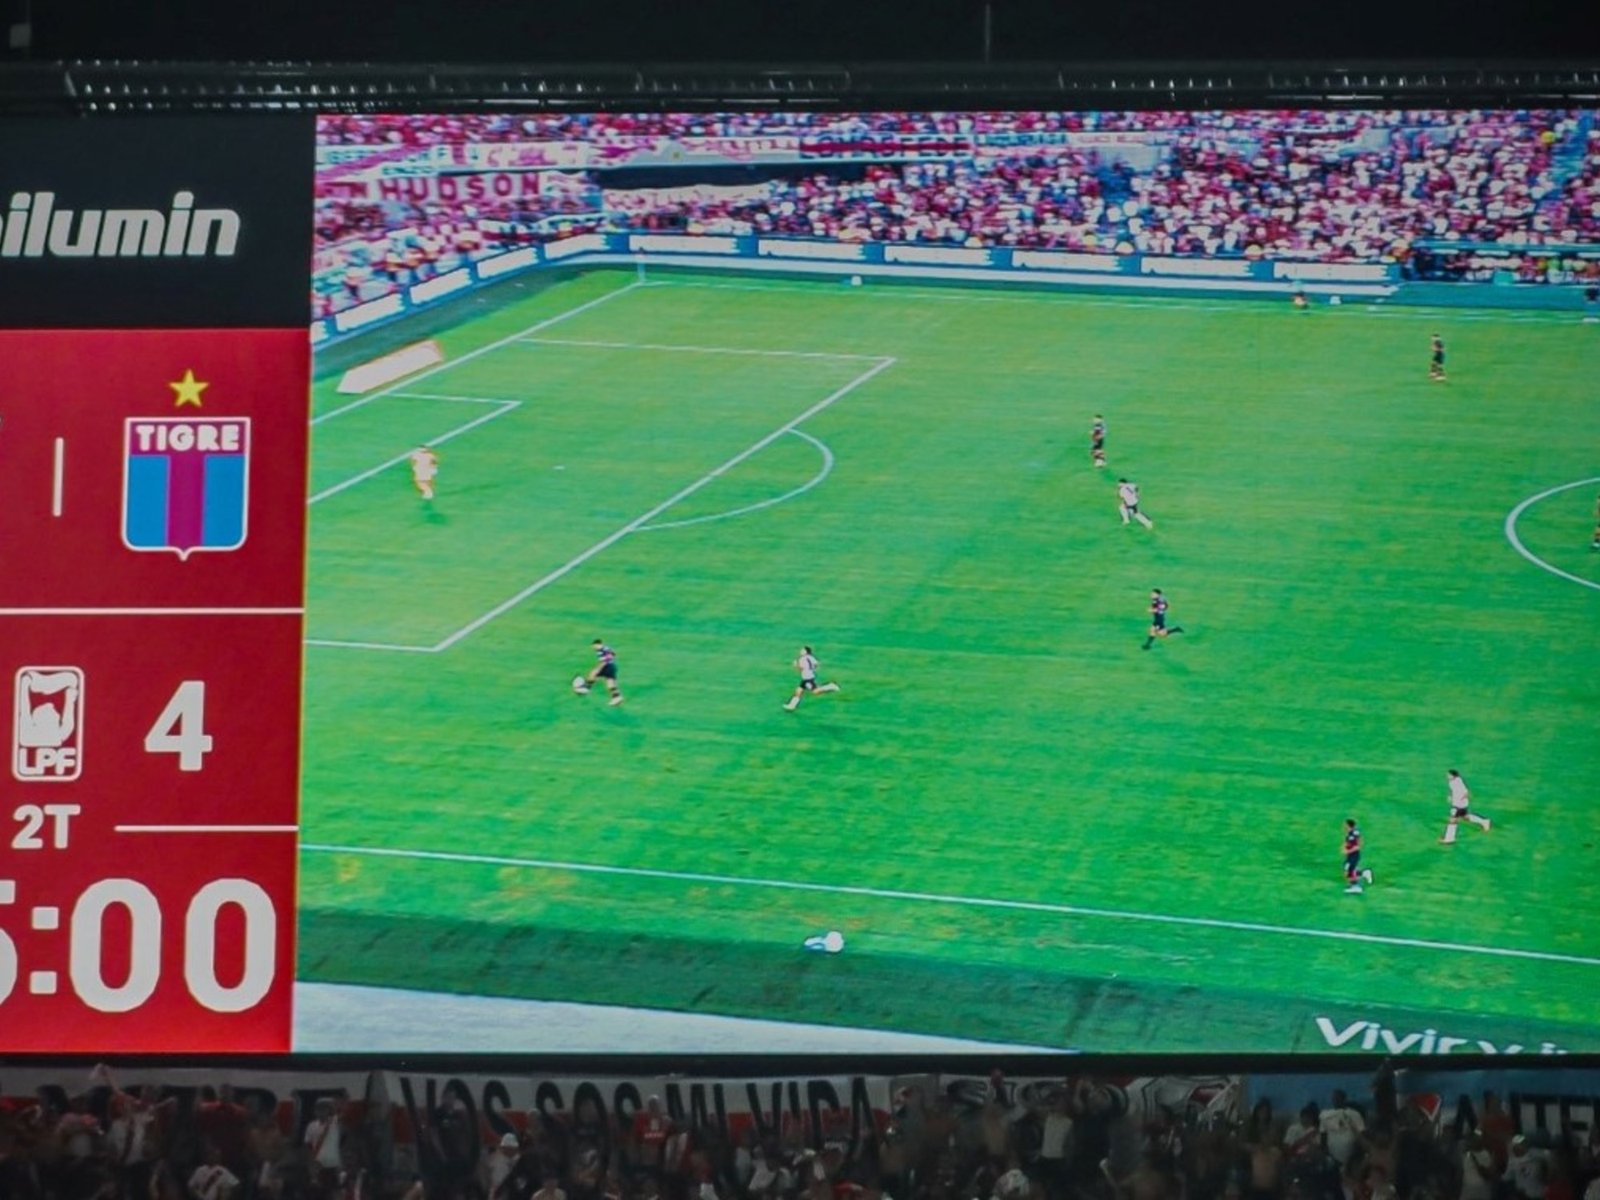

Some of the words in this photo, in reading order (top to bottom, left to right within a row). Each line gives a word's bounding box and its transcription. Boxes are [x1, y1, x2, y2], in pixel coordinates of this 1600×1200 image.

[377, 172, 541, 201] HUDSON
[0, 191, 241, 257] ilumin
[136, 424, 240, 452] TIGRE
[144, 680, 213, 772] 4
[18, 746, 77, 776] LPF
[11, 804, 81, 849] 2T
[0, 878, 277, 1013] :00
